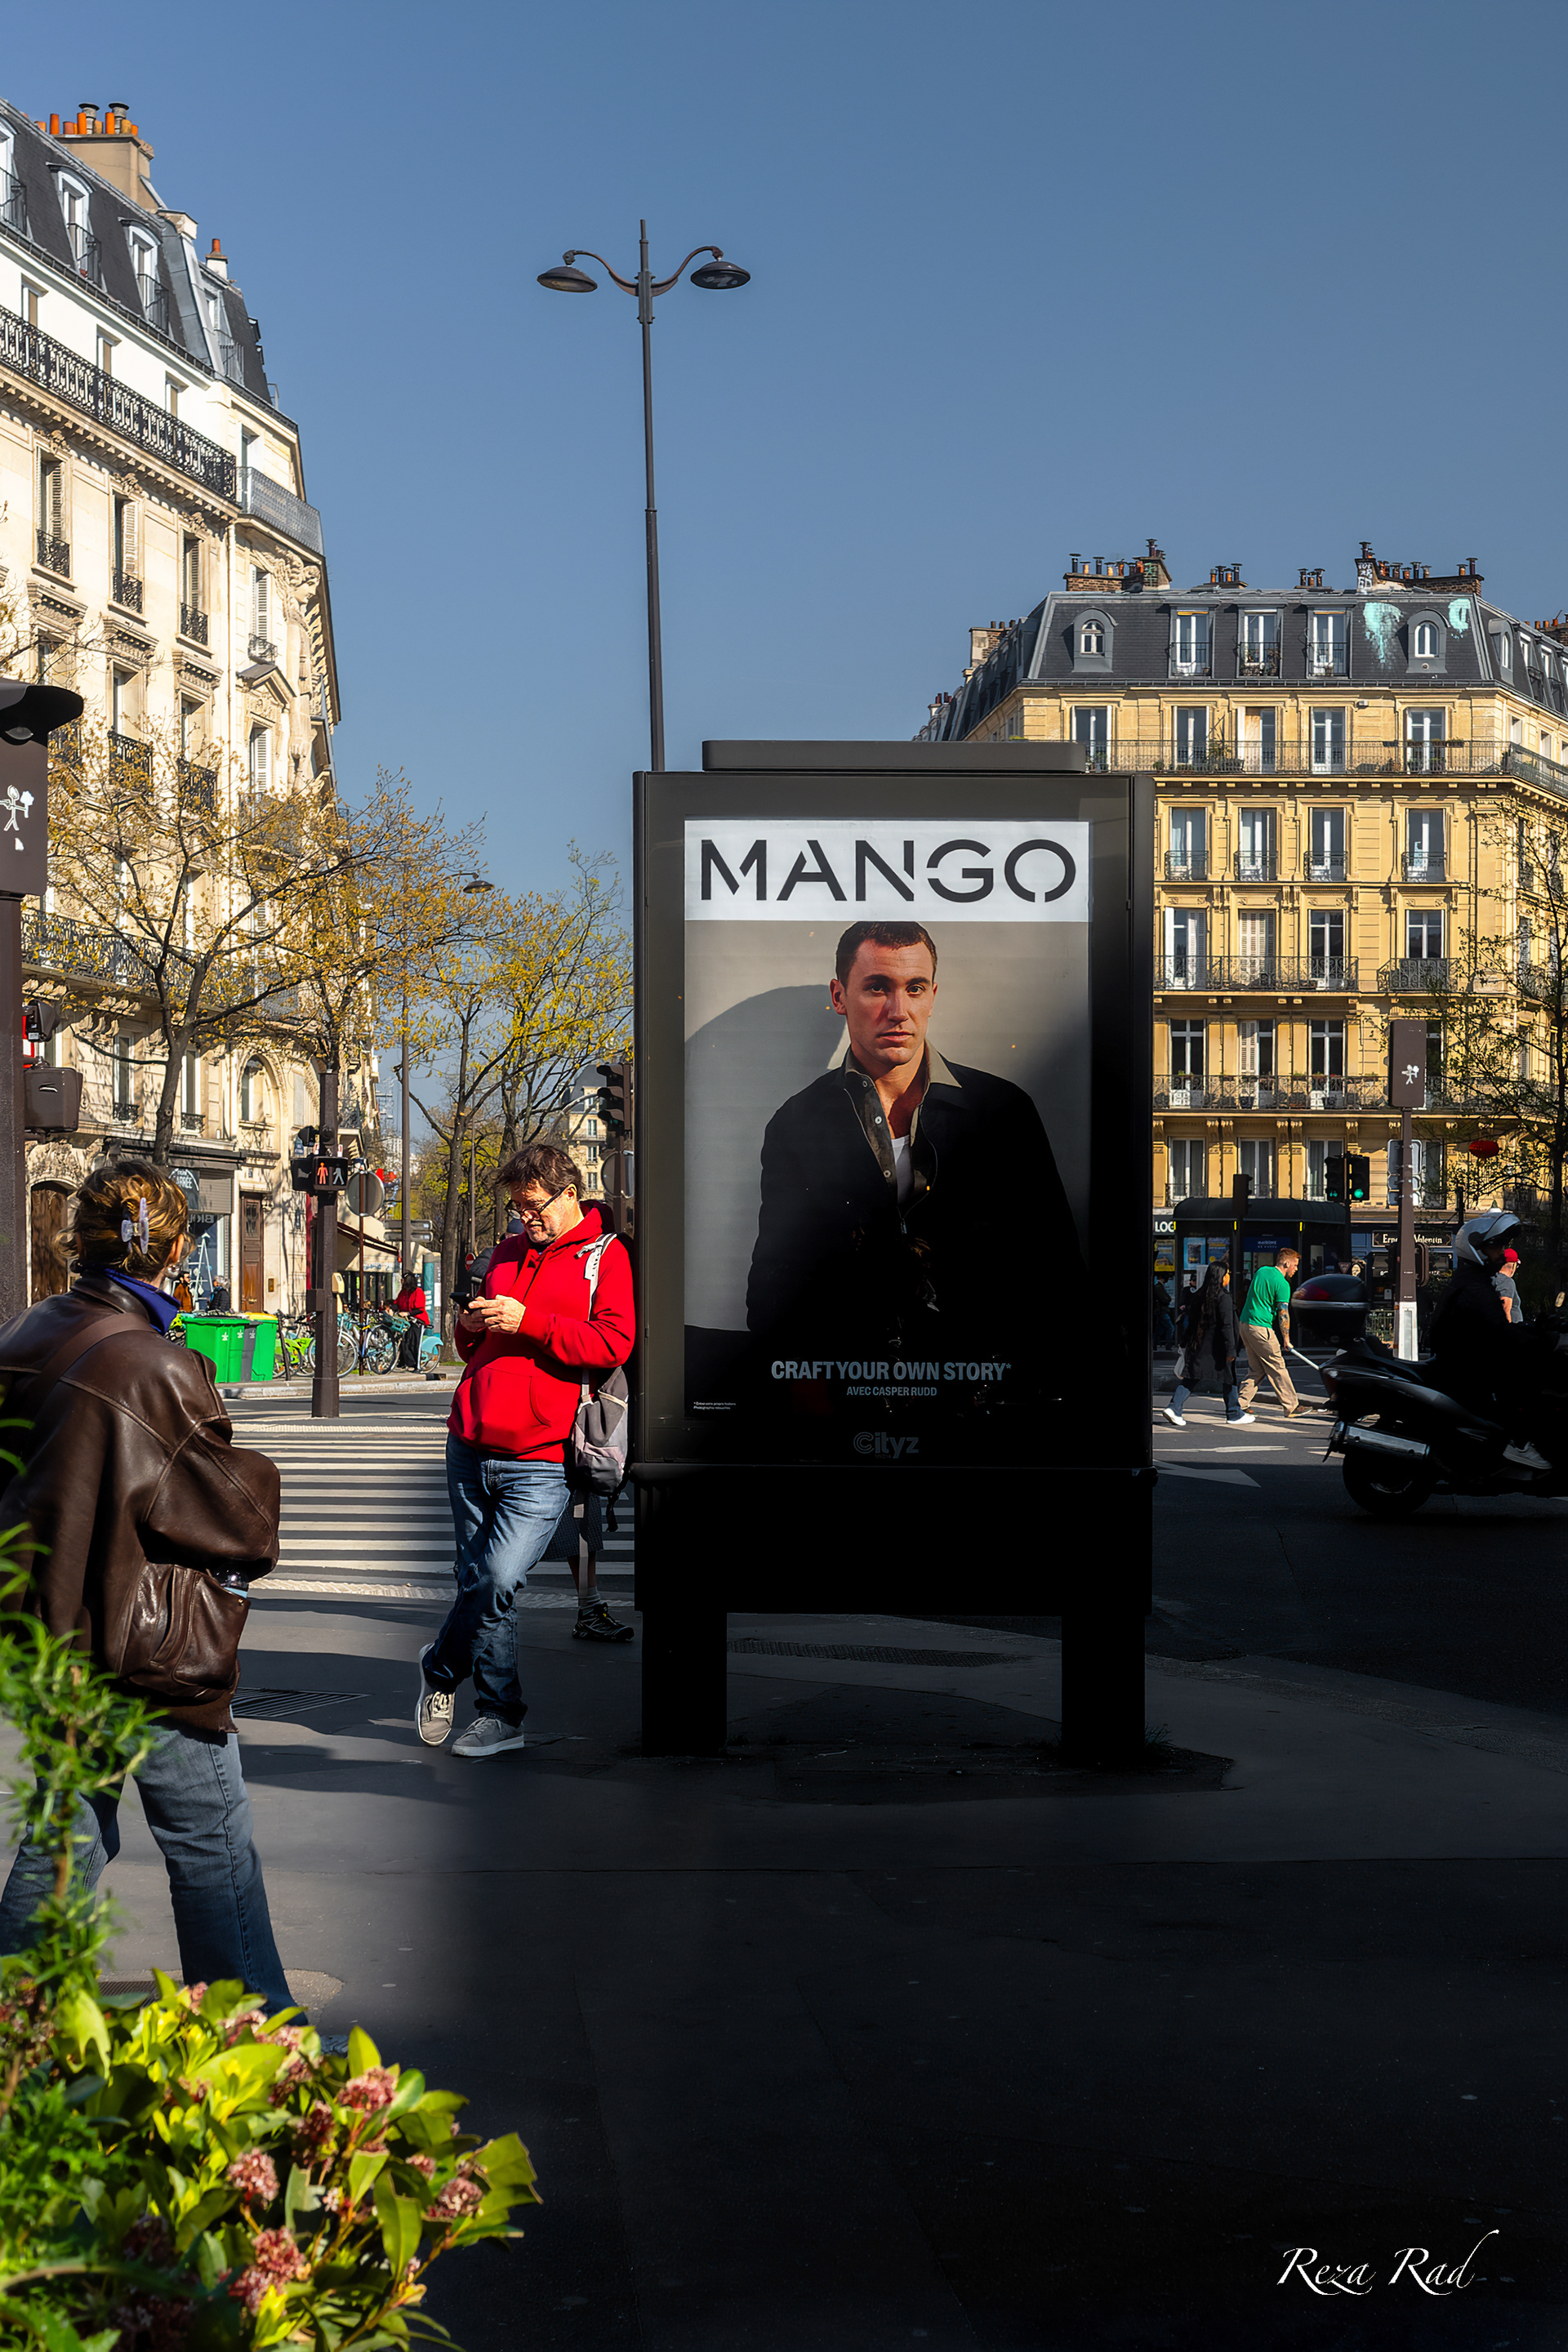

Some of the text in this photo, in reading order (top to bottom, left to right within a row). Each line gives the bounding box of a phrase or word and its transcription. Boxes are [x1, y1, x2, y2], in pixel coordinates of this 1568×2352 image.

[701, 839, 1076, 903] MANGO
[771, 1361, 835, 1379] CRAFT
[835, 1361, 889, 1379] YOUR
[893, 1361, 939, 1380] OWN
[846, 1386, 938, 1396] AVEC CASPER RUDD
[853, 1432, 920, 1459] Cityz
